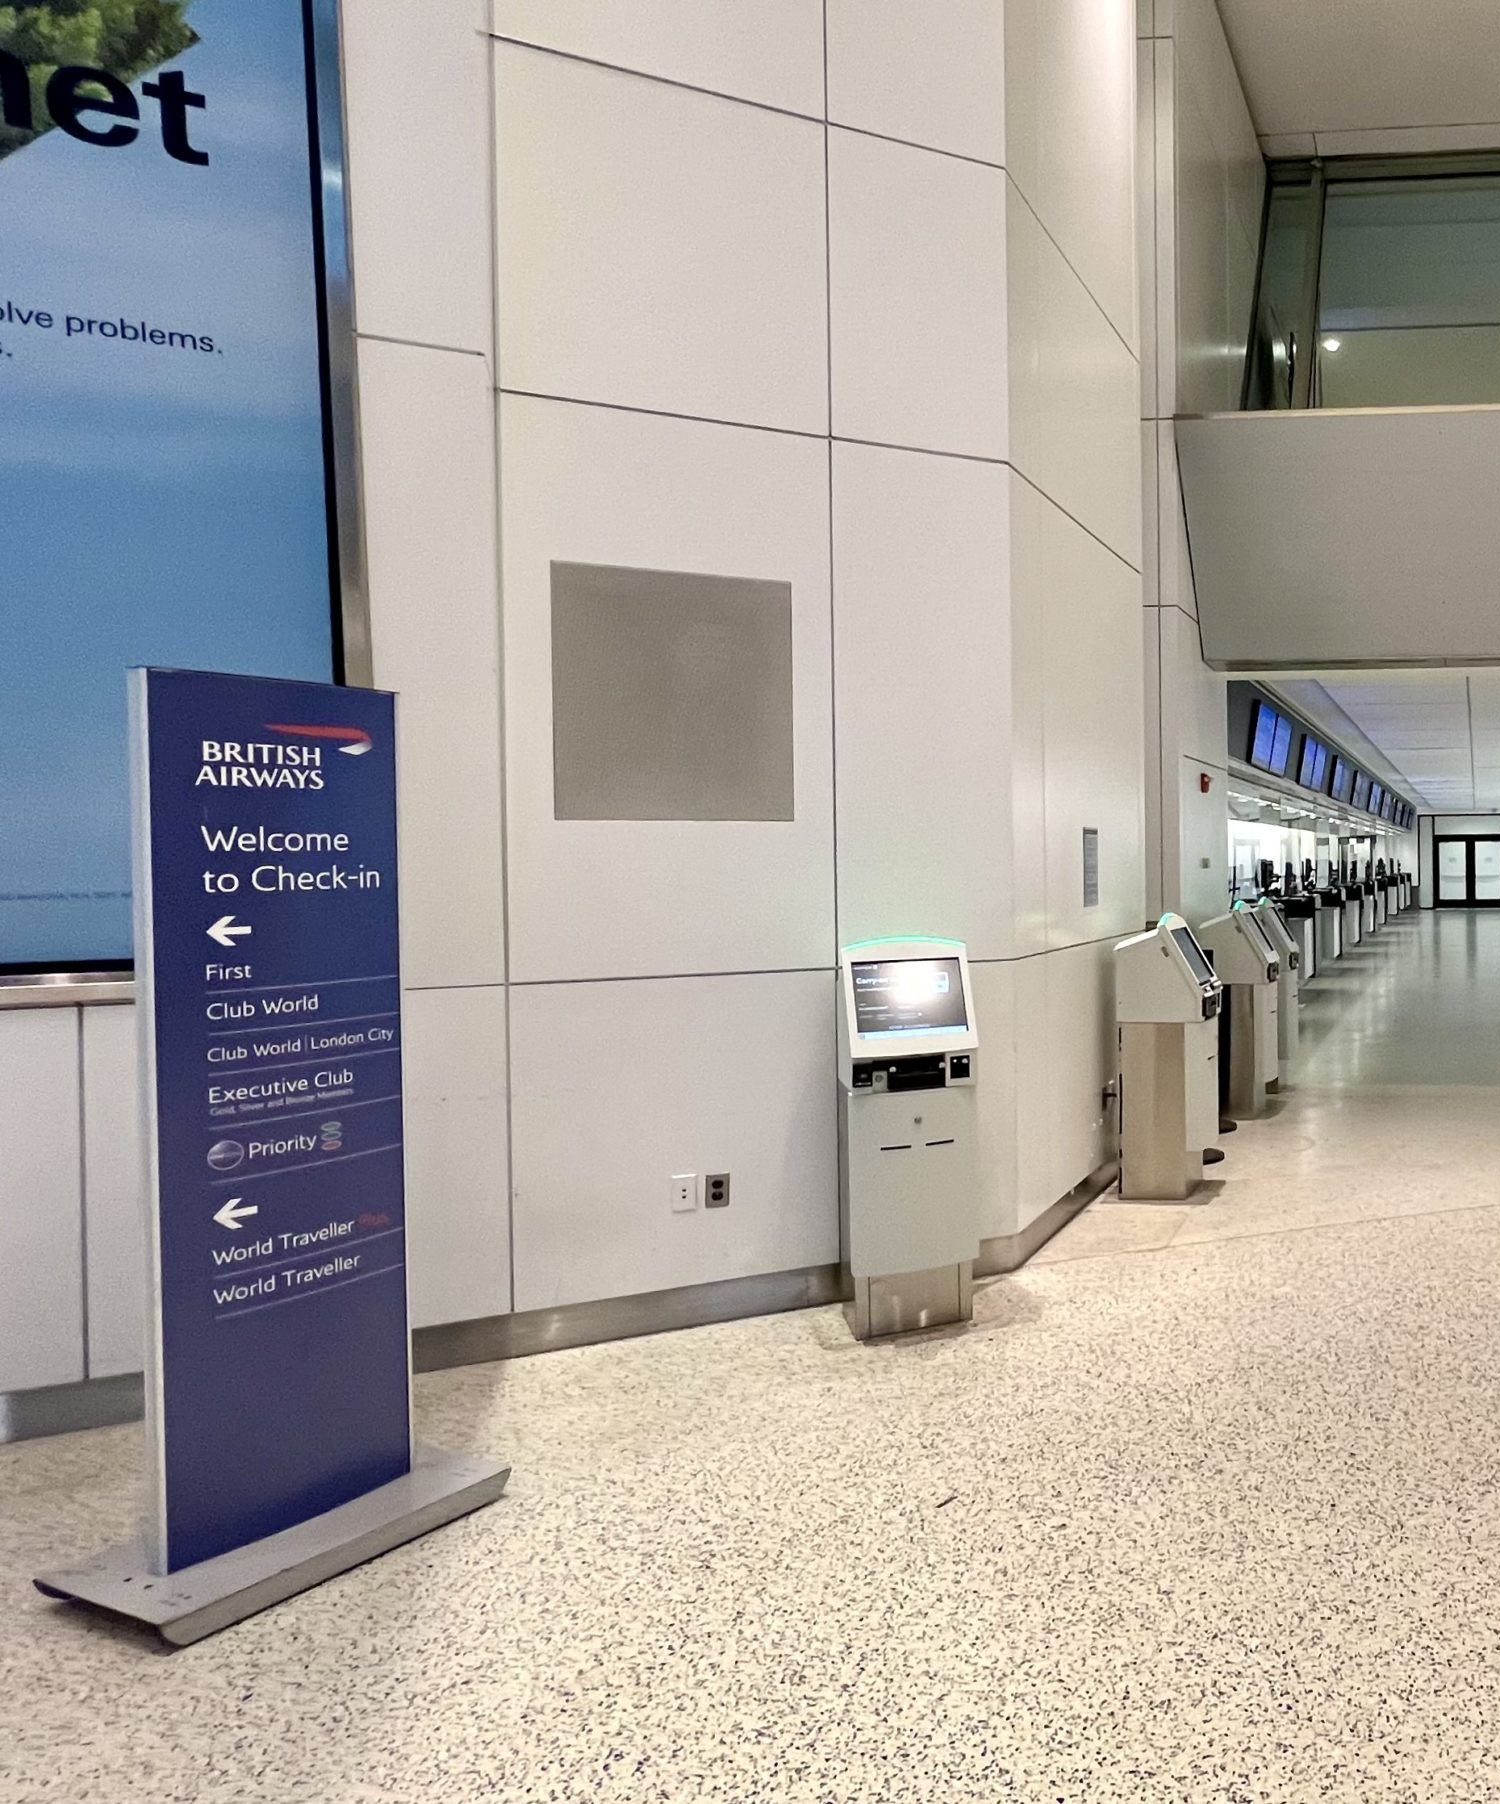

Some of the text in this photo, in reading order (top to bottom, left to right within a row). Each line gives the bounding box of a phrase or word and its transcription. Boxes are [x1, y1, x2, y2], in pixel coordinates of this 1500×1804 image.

[0, 301, 223, 354] lve problems.
[202, 740, 321, 766] BRITISH
[195, 765, 325, 789] AIRWAYS
[201, 826, 349, 851] Welcome
[203, 865, 380, 893] to Check-in
[206, 964, 252, 981] First
[206, 994, 319, 1020] Club World
[207, 1027, 394, 1062] Club World London City
[208, 1077, 308, 1104] Executive
[314, 1069, 354, 1086] Club
[249, 1134, 318, 1159] Priority
[212, 1238, 273, 1266] World
[278, 1220, 355, 1249] Traveller
[213, 1255, 361, 1304] World Traveller
